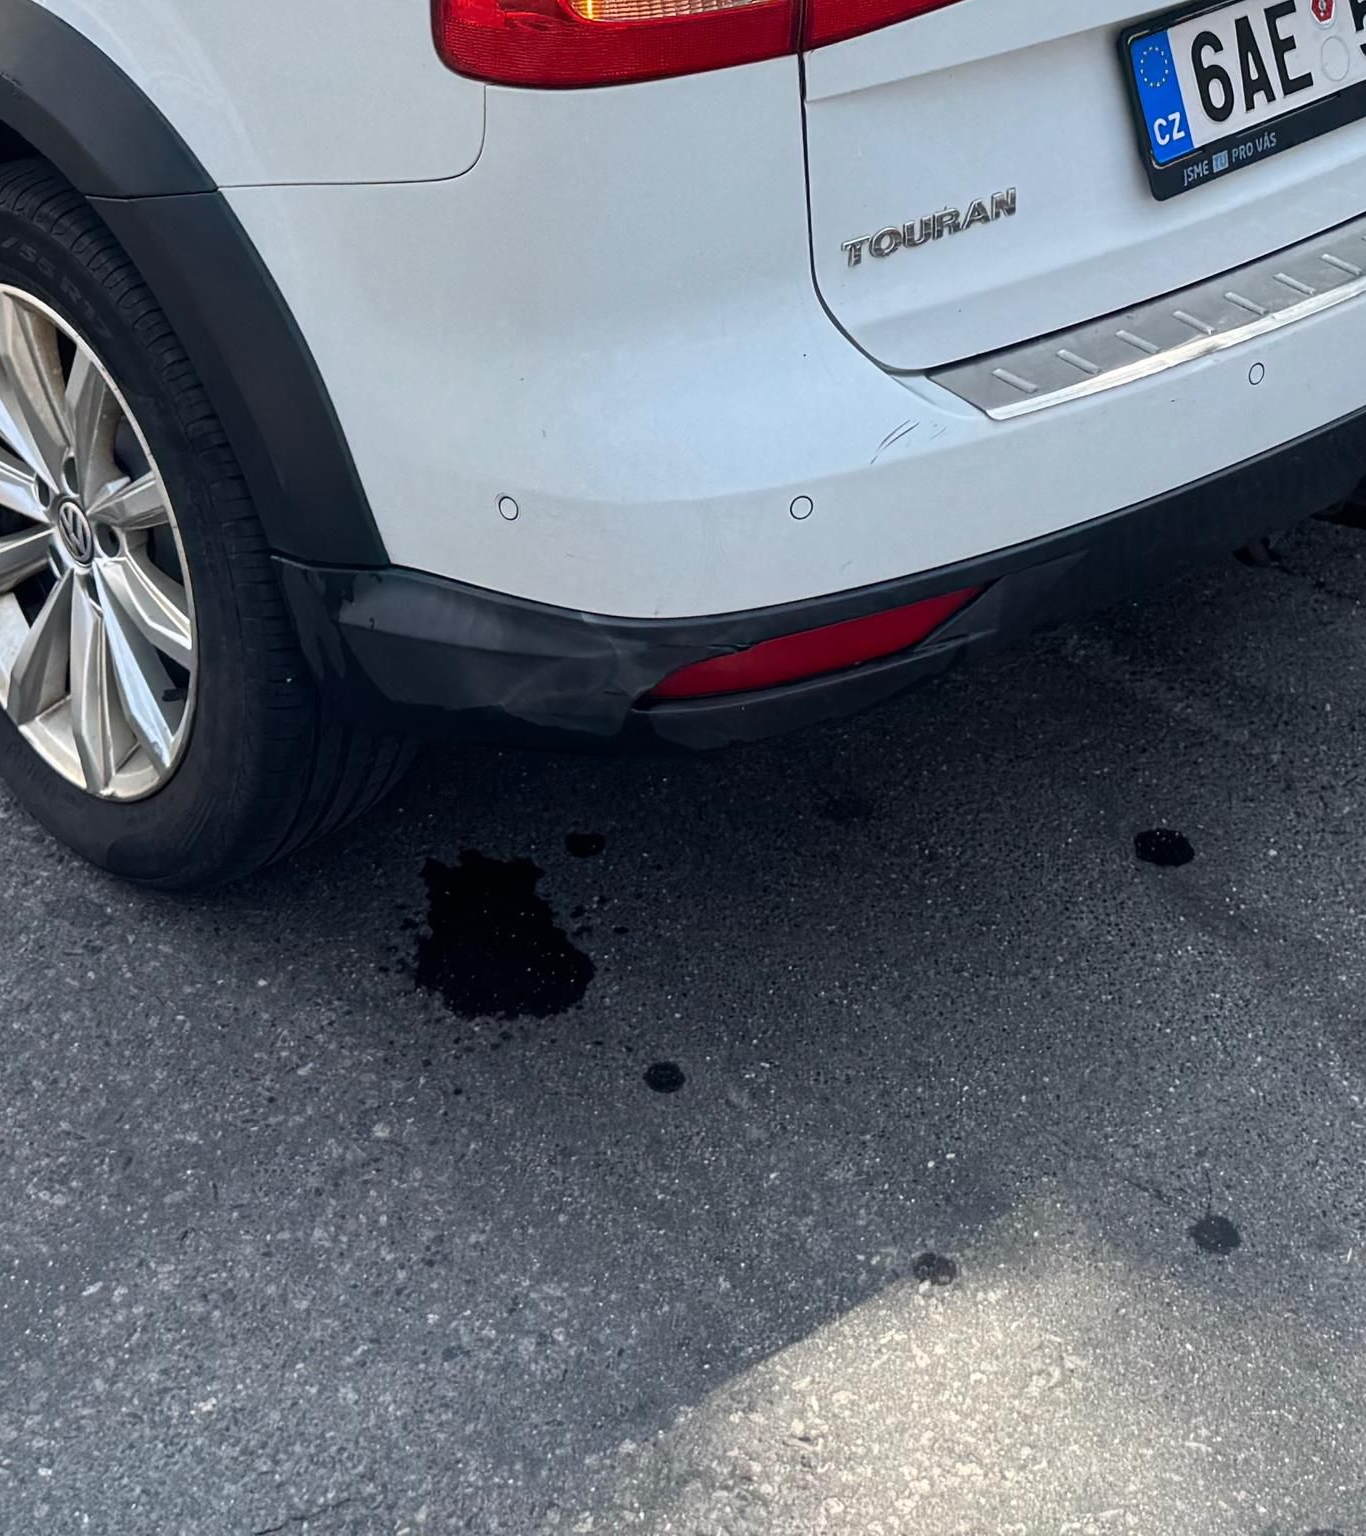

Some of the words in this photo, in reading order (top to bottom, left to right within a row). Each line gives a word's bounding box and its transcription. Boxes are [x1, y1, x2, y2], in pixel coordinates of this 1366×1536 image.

[1190, 0, 1314, 122] 6AE
[1153, 111, 1185, 146] CZ
[1183, 159, 1210, 186] JSME
[1232, 142, 1254, 163] PRO
[1255, 131, 1277, 153] VÁS
[841, 187, 1017, 267] TOURAN
